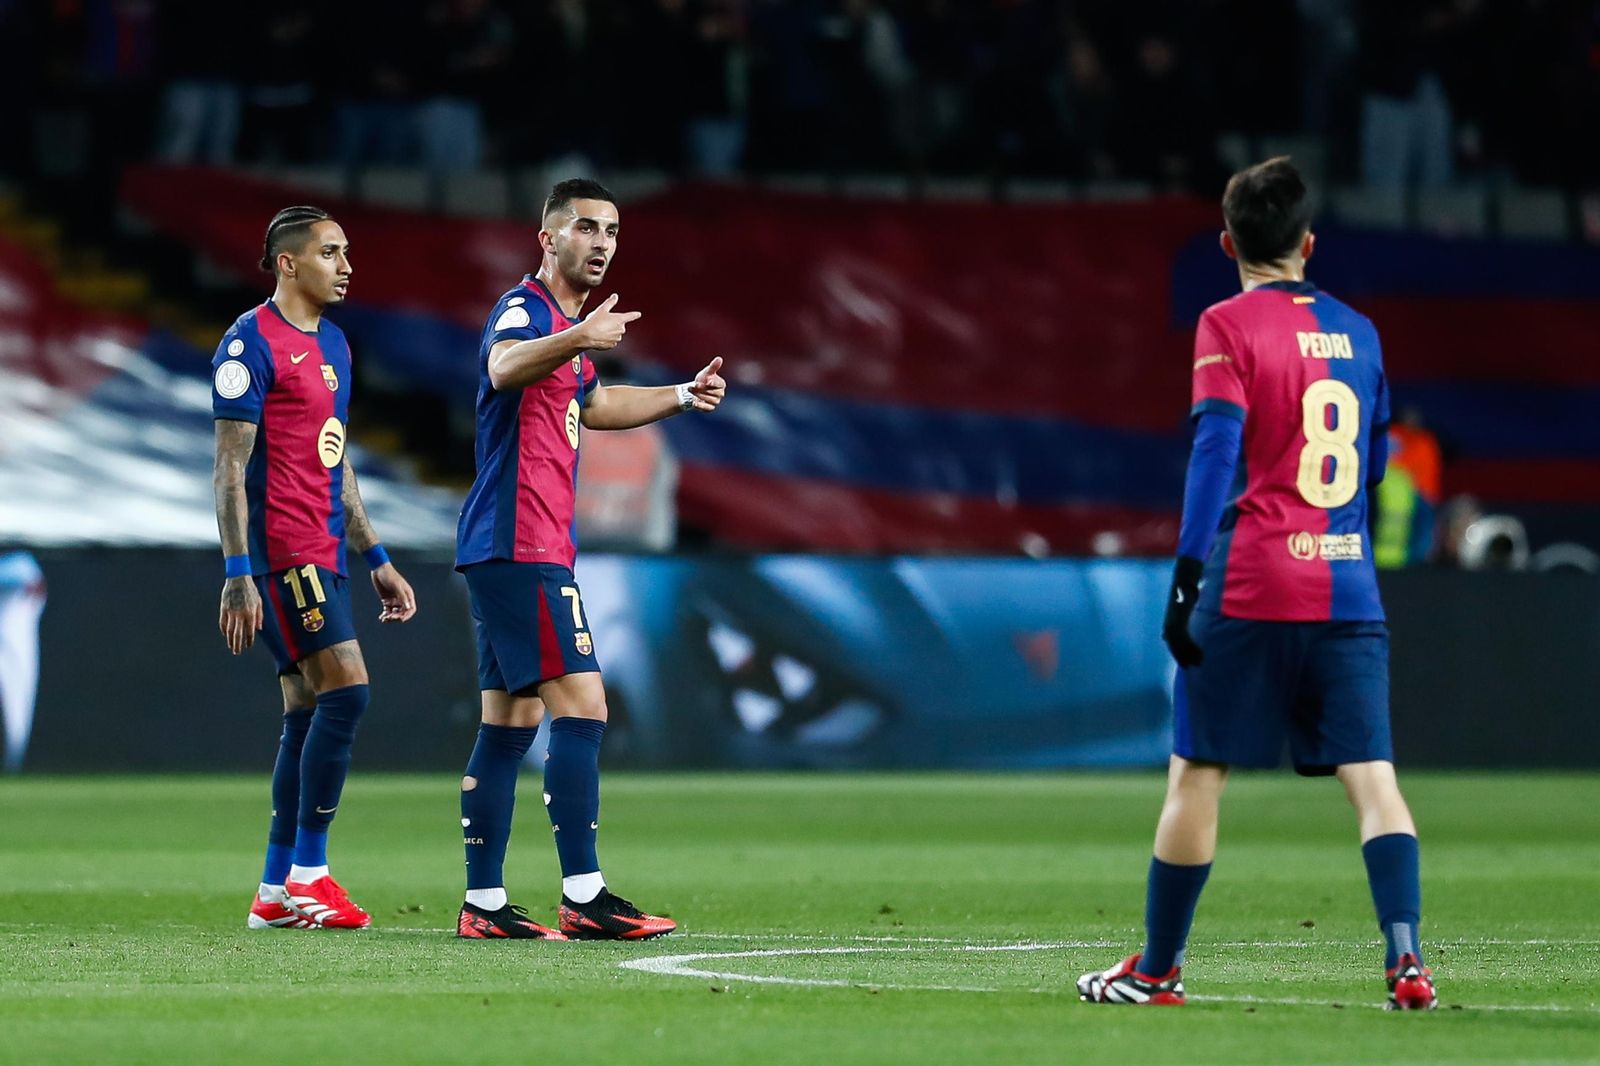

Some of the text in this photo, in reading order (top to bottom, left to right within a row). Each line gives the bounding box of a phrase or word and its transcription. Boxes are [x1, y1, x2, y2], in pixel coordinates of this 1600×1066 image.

[1296, 331, 1354, 359] PEDRI
[1296, 378, 1360, 509] 8
[283, 563, 326, 609] 11
[560, 586, 584, 629] 7
